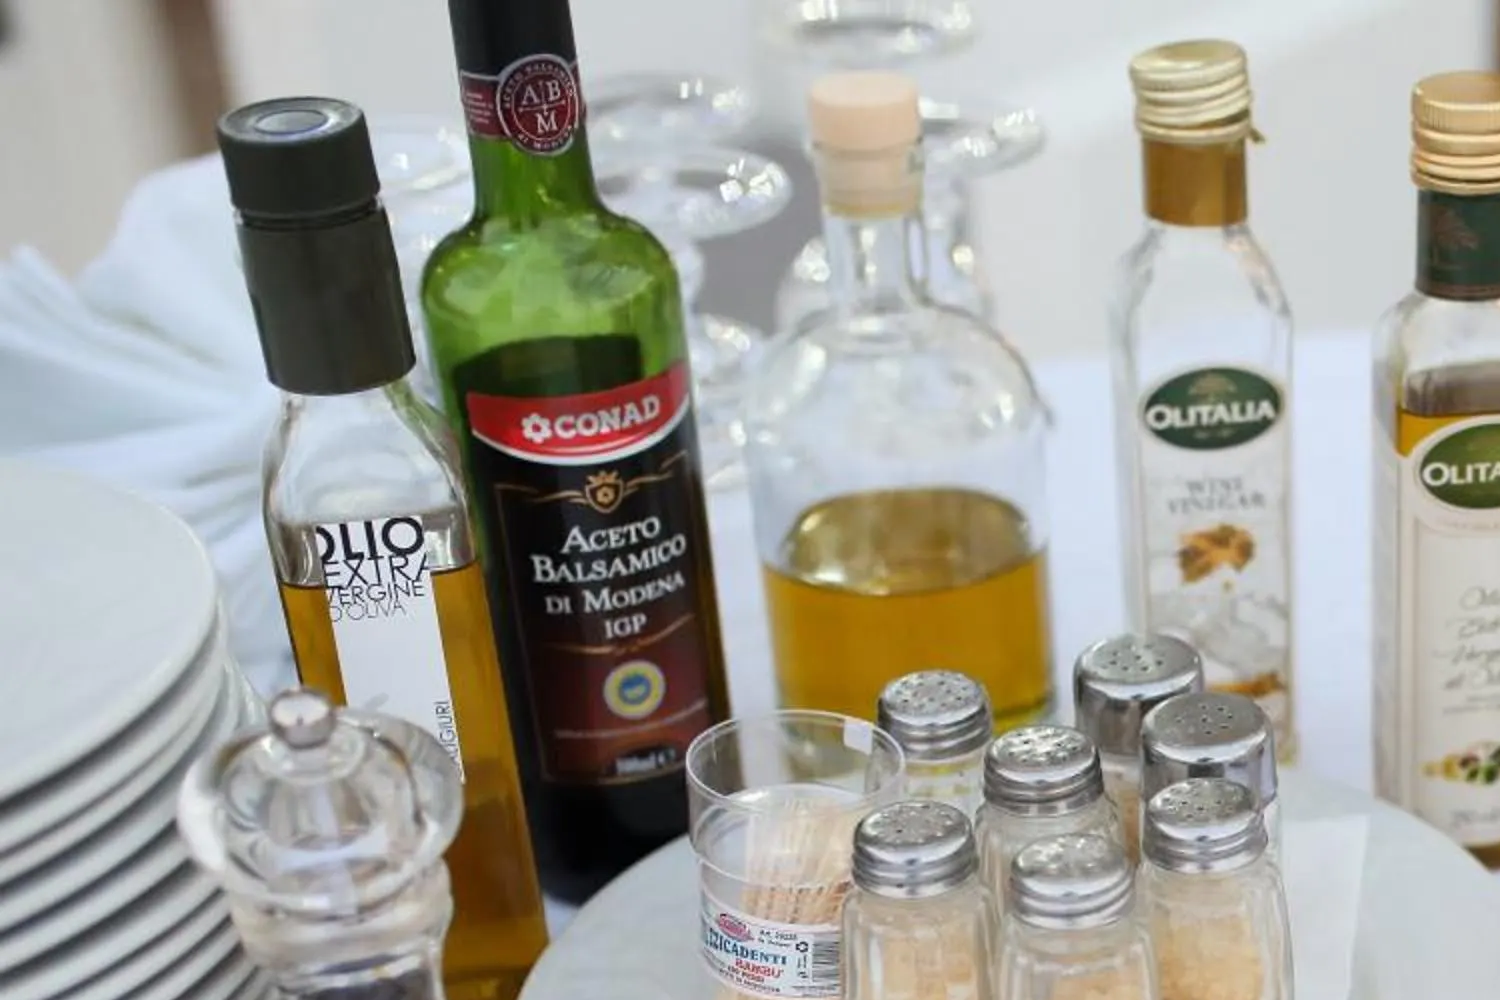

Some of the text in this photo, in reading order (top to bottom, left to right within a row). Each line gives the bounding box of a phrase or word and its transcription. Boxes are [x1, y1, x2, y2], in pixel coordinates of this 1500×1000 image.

[522, 79, 561, 105] A B
[535, 109, 558, 135] M
[553, 394, 661, 440] CONAD
[1145, 399, 1276, 431] OLITALIA
[560, 515, 661, 555] ACETO
[530, 533, 687, 584] BALSAMICO
[544, 570, 687, 615] DI MODENA
[603, 612, 648, 641] IGP
